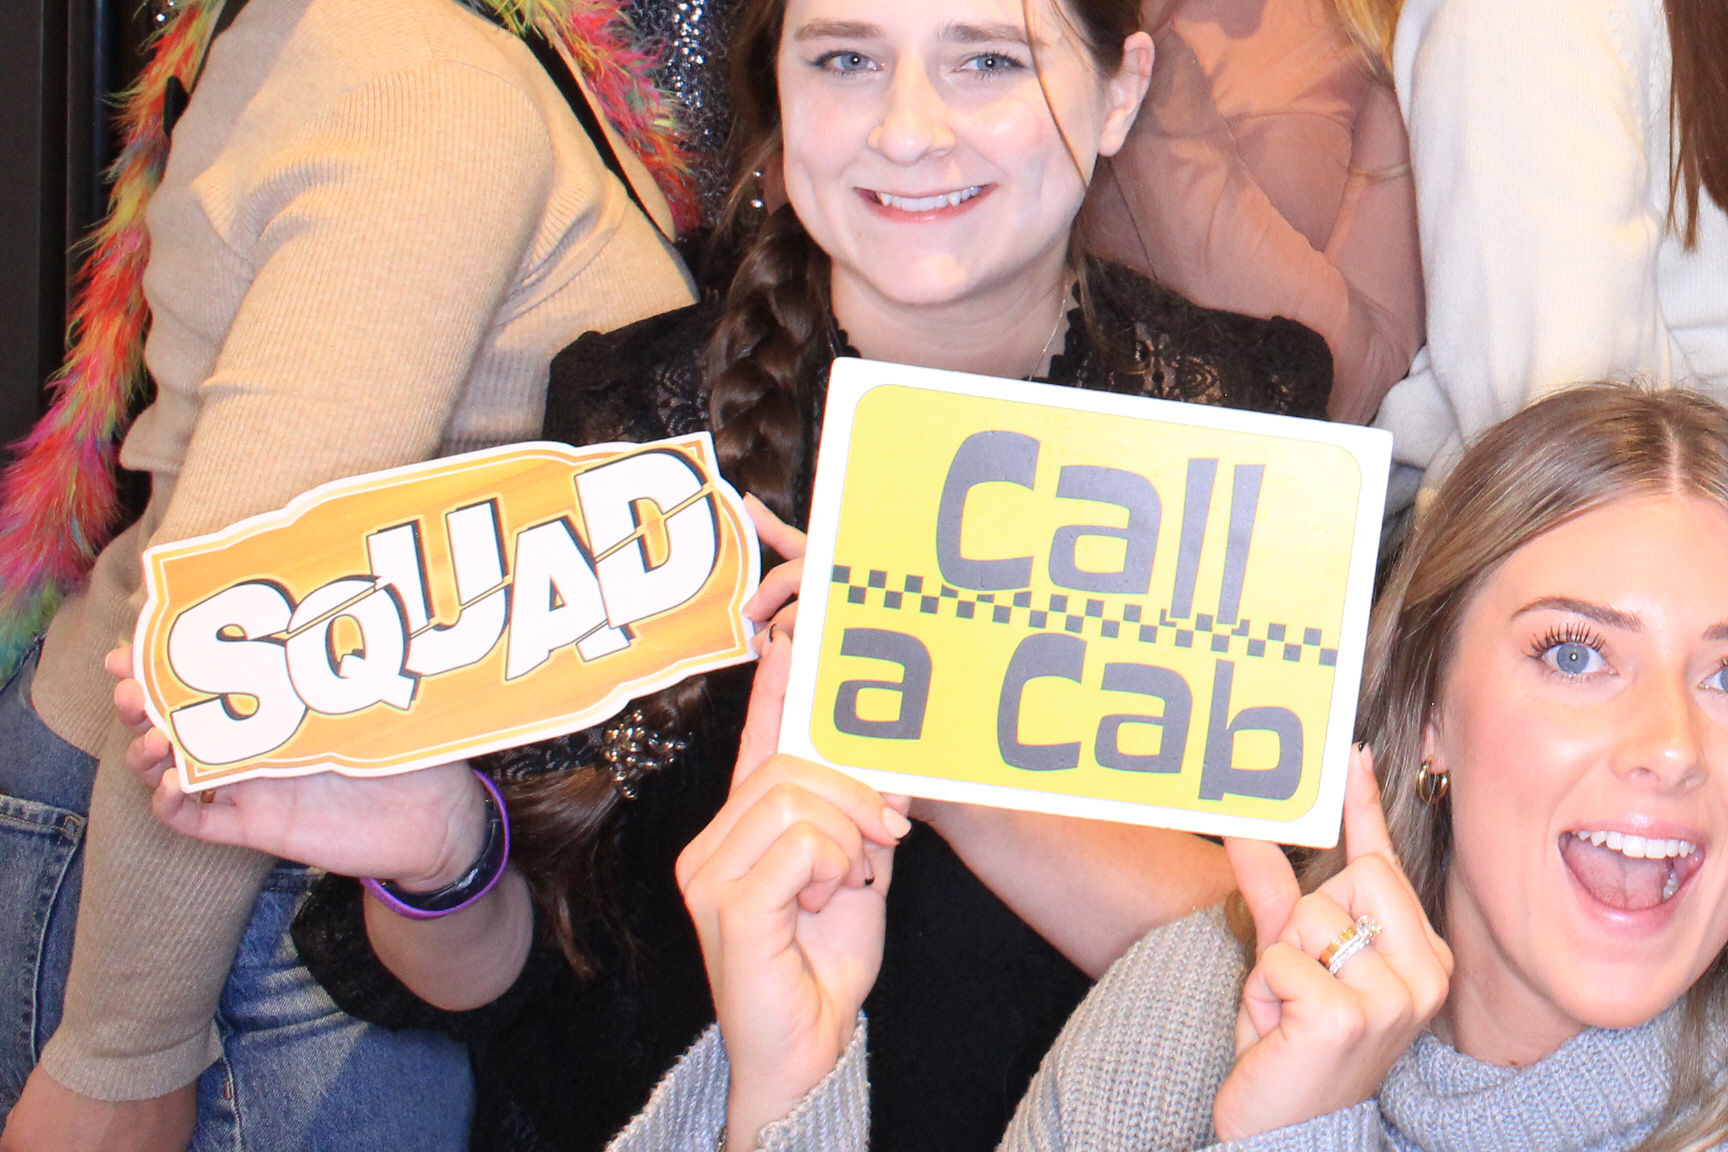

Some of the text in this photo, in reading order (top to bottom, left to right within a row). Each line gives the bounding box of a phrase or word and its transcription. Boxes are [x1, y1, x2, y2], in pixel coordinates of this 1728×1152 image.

[168, 448, 723, 765] SQUAD
[934, 430, 1267, 625] Call
[832, 627, 1305, 802] a Cab
